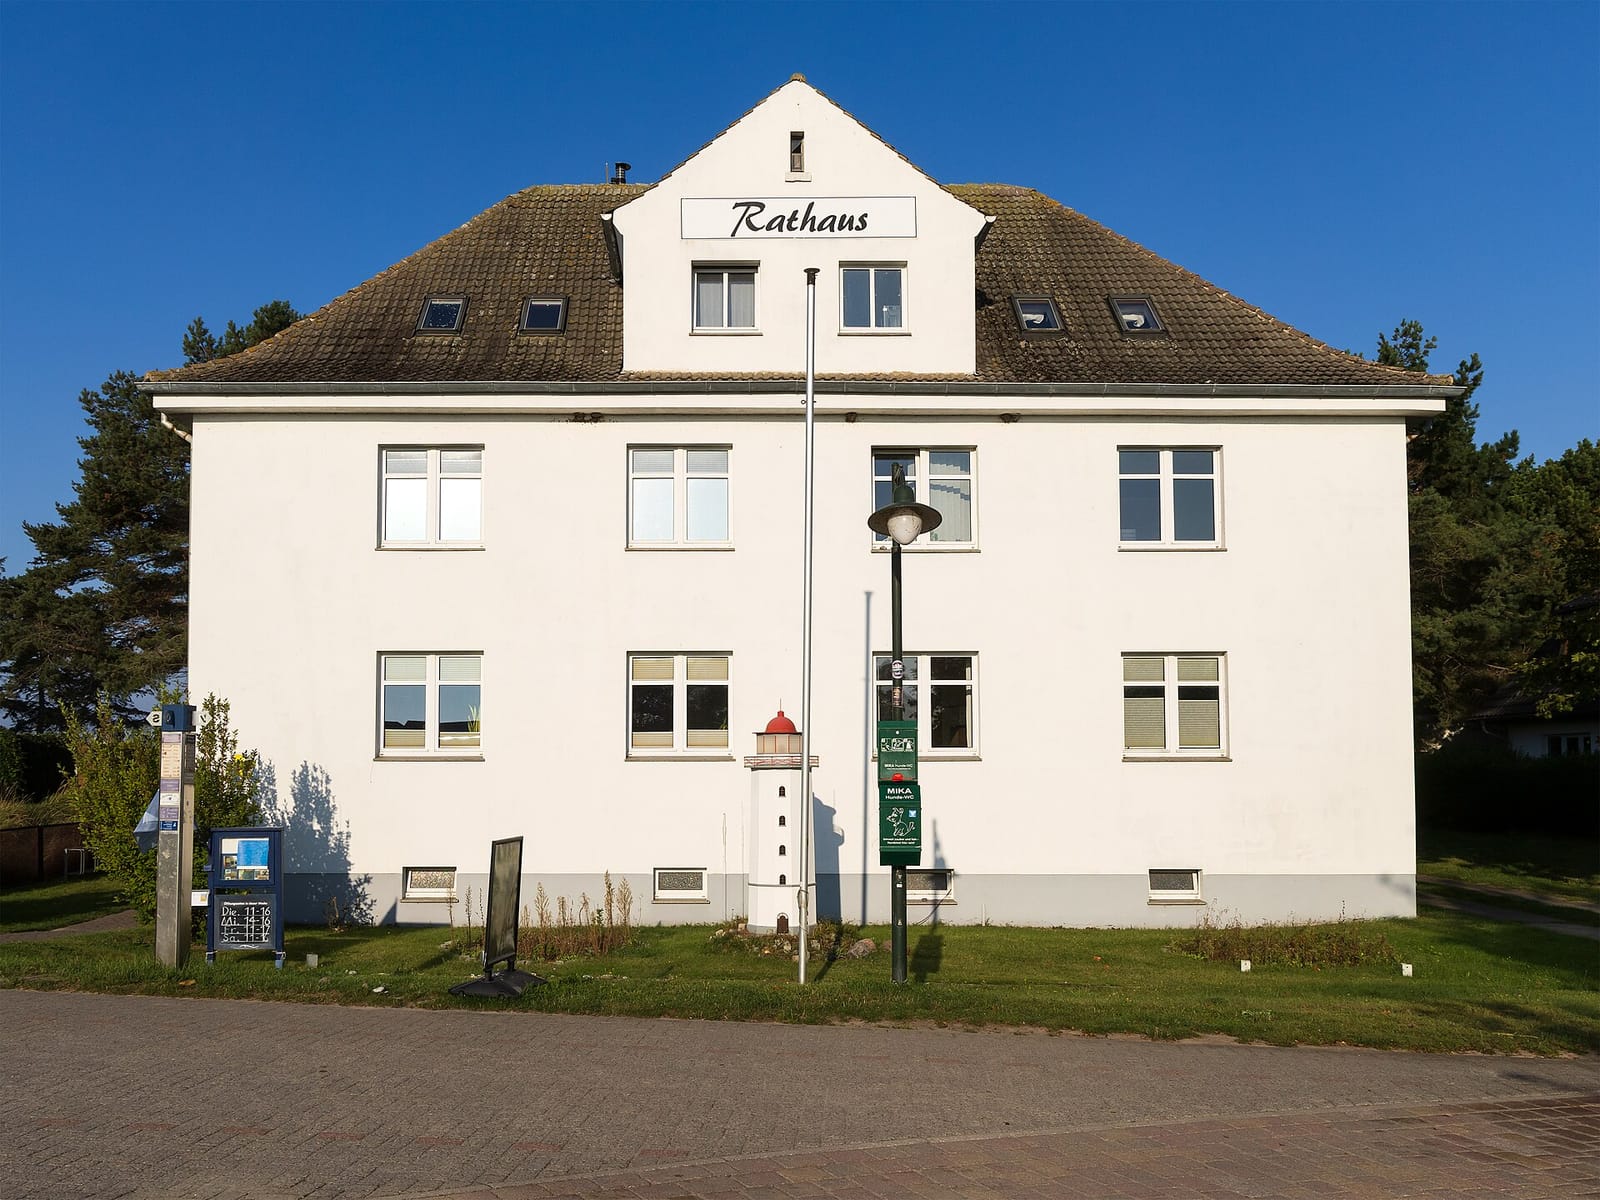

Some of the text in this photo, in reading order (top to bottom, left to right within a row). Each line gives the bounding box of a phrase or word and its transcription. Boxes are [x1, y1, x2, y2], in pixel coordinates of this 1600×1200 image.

[731, 201, 868, 237] Rathaus
[887, 787, 912, 795] MIKA
[222, 906, 271, 917] Die. 11-16
[221, 916, 240, 926] Mi.
[222, 933, 240, 942] Sa.
